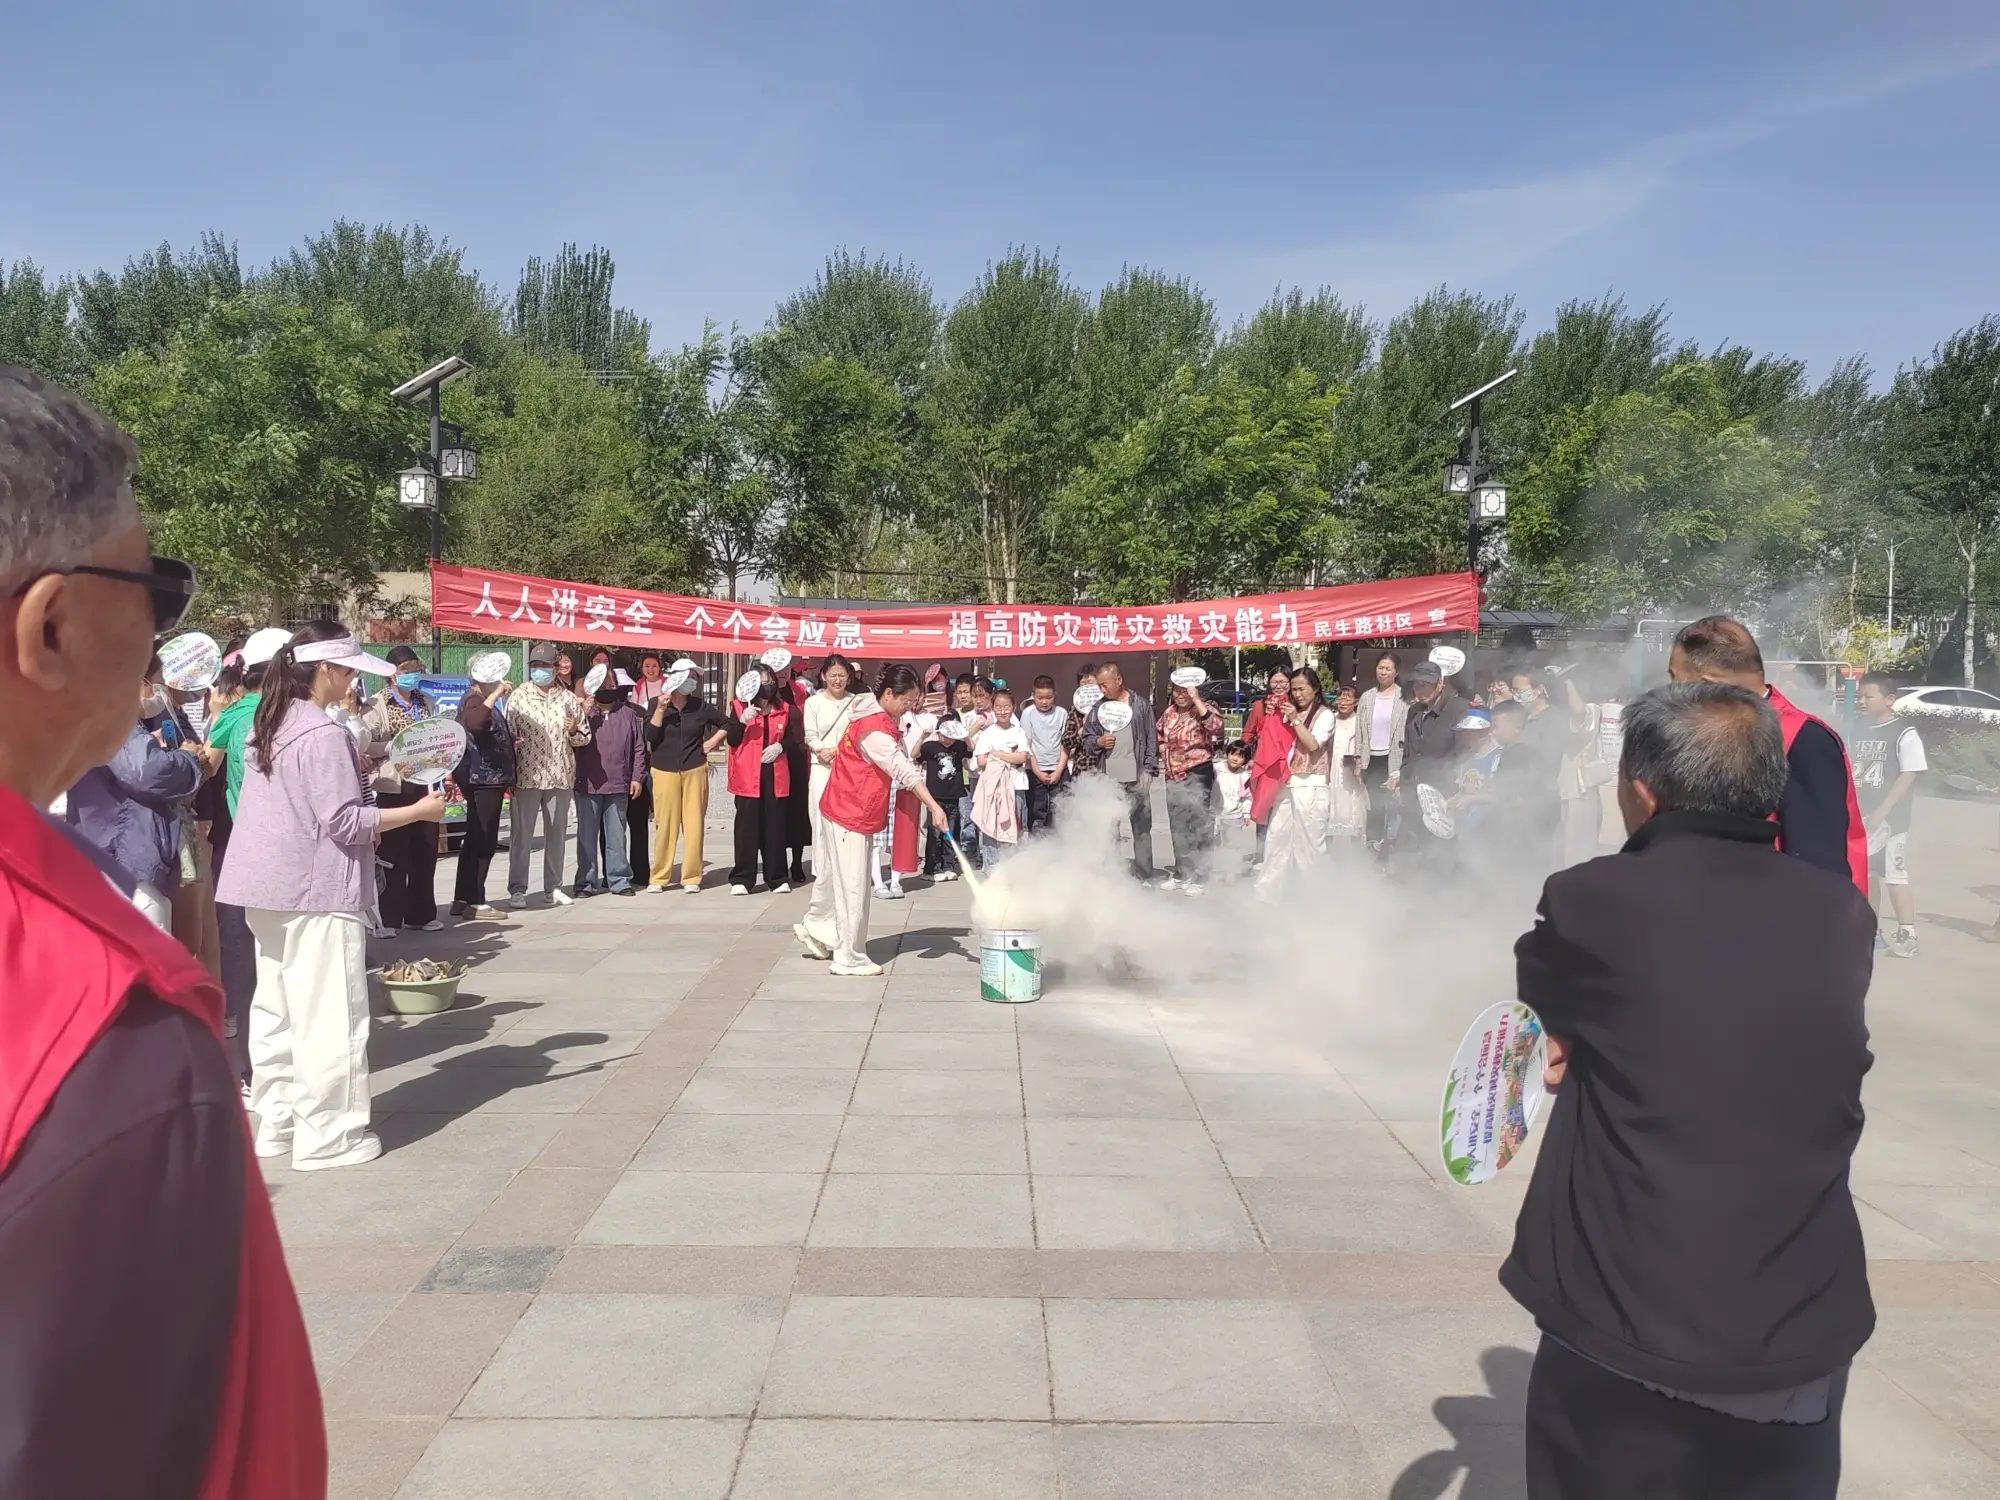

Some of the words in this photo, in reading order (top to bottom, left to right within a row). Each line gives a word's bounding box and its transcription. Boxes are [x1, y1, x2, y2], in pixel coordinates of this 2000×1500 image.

[471, 581, 655, 634] 人人讲安全
[1314, 612, 1413, 638] 民生路社区
